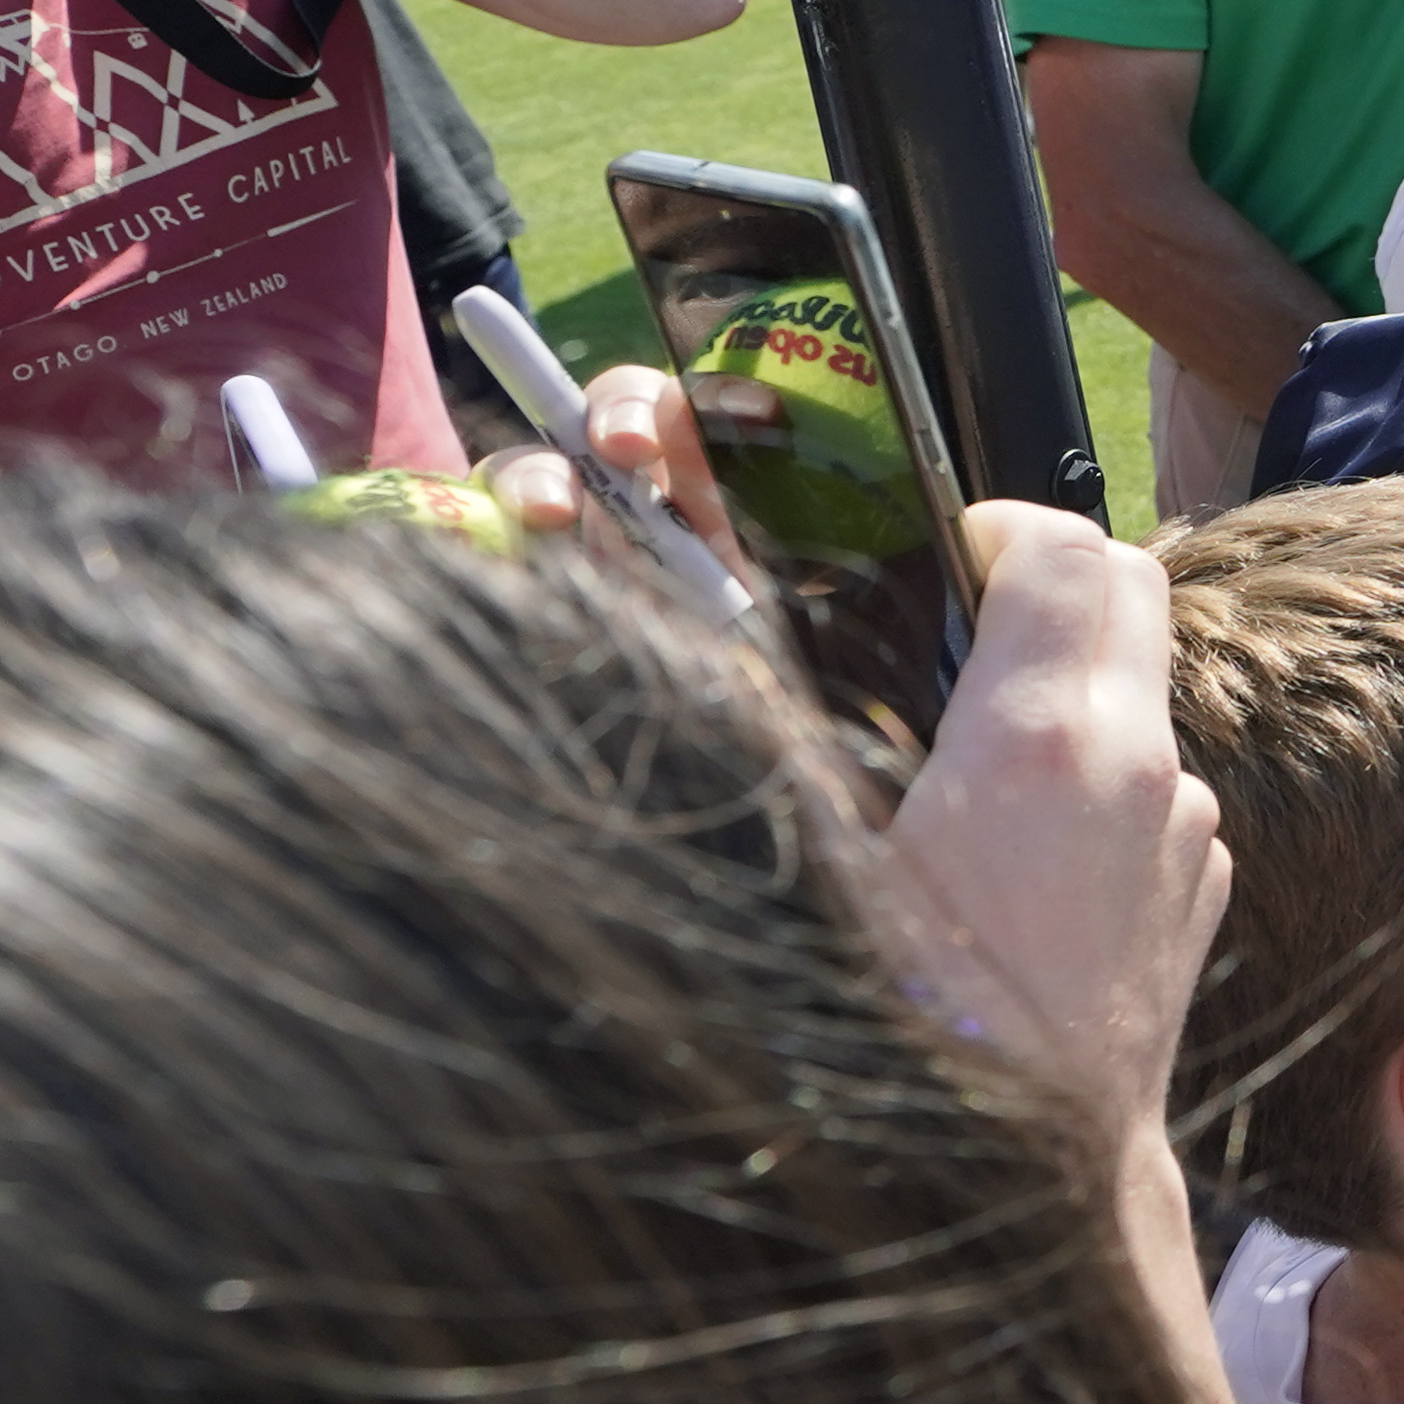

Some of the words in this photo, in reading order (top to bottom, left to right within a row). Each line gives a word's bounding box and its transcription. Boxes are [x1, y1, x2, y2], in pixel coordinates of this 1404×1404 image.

[0, 192, 206, 283] VENTURE
[227, 136, 353, 204] CAPITAL
[12, 335, 118, 382] OTAGO
[139, 307, 190, 339] NEW
[200, 272, 289, 317] ZEALAND
